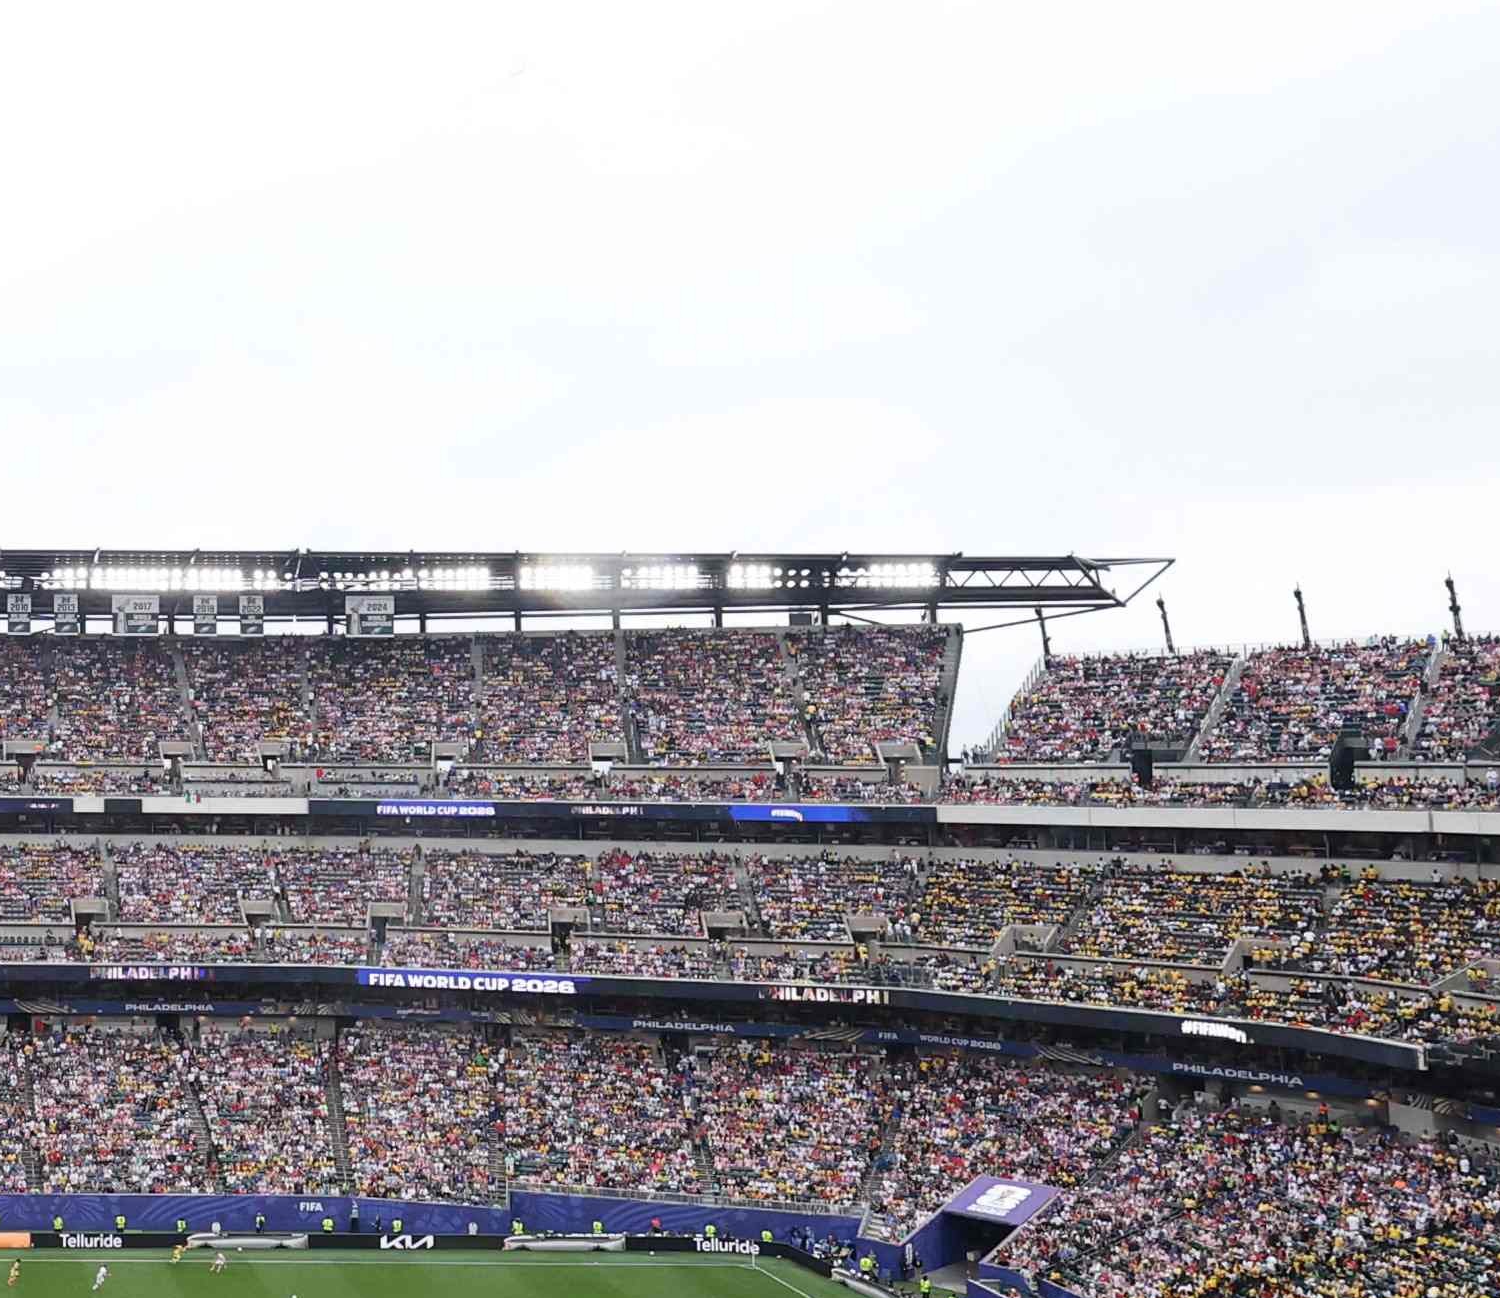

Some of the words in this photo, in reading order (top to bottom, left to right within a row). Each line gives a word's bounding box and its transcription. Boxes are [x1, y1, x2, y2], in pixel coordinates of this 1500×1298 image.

[376, 805, 399, 815] FIFA
[400, 805, 436, 815] WORLD
[437, 806, 458, 816] CUP
[369, 973, 403, 988] FIFA
[405, 974, 471, 992] WORLD
[472, 976, 509, 993] CUP
[510, 979, 575, 994] 2026
[125, 1003, 214, 1013] PHILADELPHIA
[632, 1020, 735, 1033] PHILADELPHIA
[878, 1031, 898, 1041] FIFA
[920, 1034, 949, 1045] WORLD
[950, 1037, 969, 1047] CUP
[1172, 1062, 1304, 1087] PHILADELPHIA
[299, 1201, 324, 1212] FIFA
[59, 1233, 122, 1248] Telluride
[694, 1237, 760, 1256] Telluride
